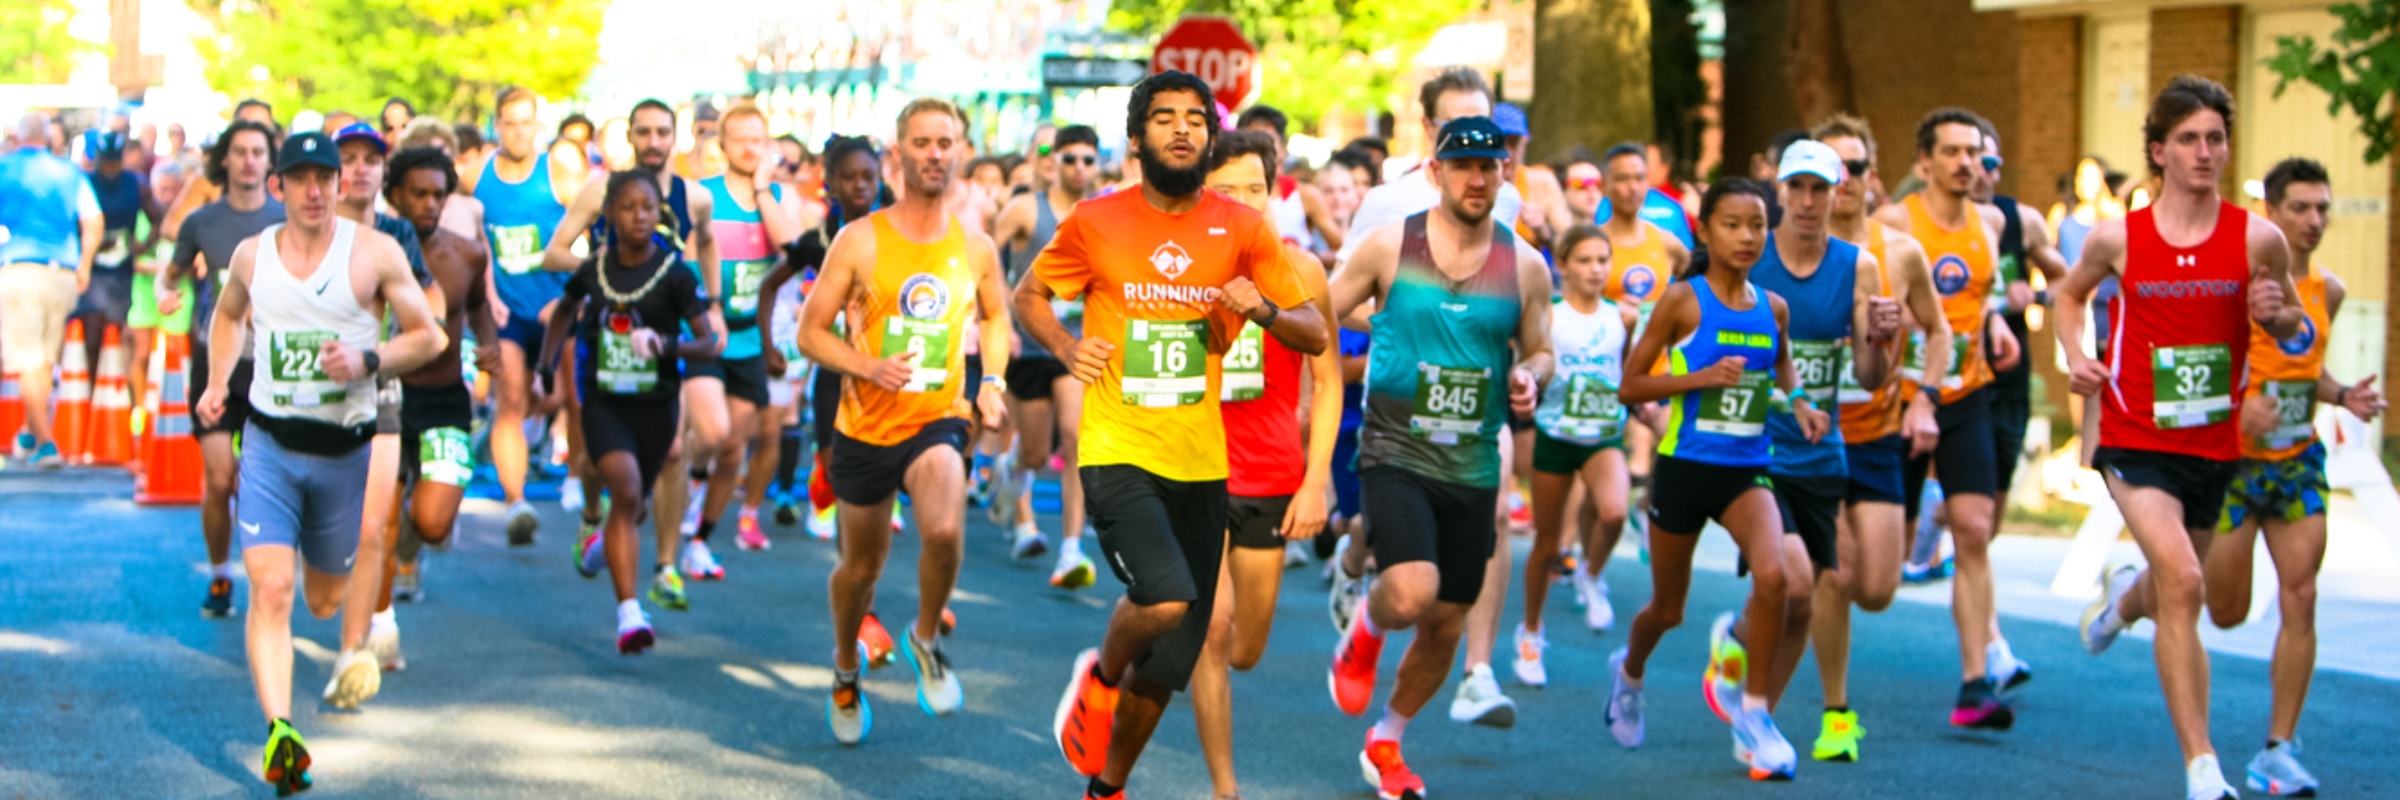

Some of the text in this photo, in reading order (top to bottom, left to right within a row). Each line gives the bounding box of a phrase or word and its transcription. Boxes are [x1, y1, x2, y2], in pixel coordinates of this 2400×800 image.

[1158, 48, 1249, 91] STOP
[1124, 282, 1217, 303] RUNNING
[2136, 281, 2239, 297] WOOTTON
[1148, 340, 1187, 372] 16
[1793, 356, 1835, 385] 261
[2175, 364, 2211, 395] 32
[1427, 384, 1477, 416] 845
[1720, 387, 1755, 417] 57
